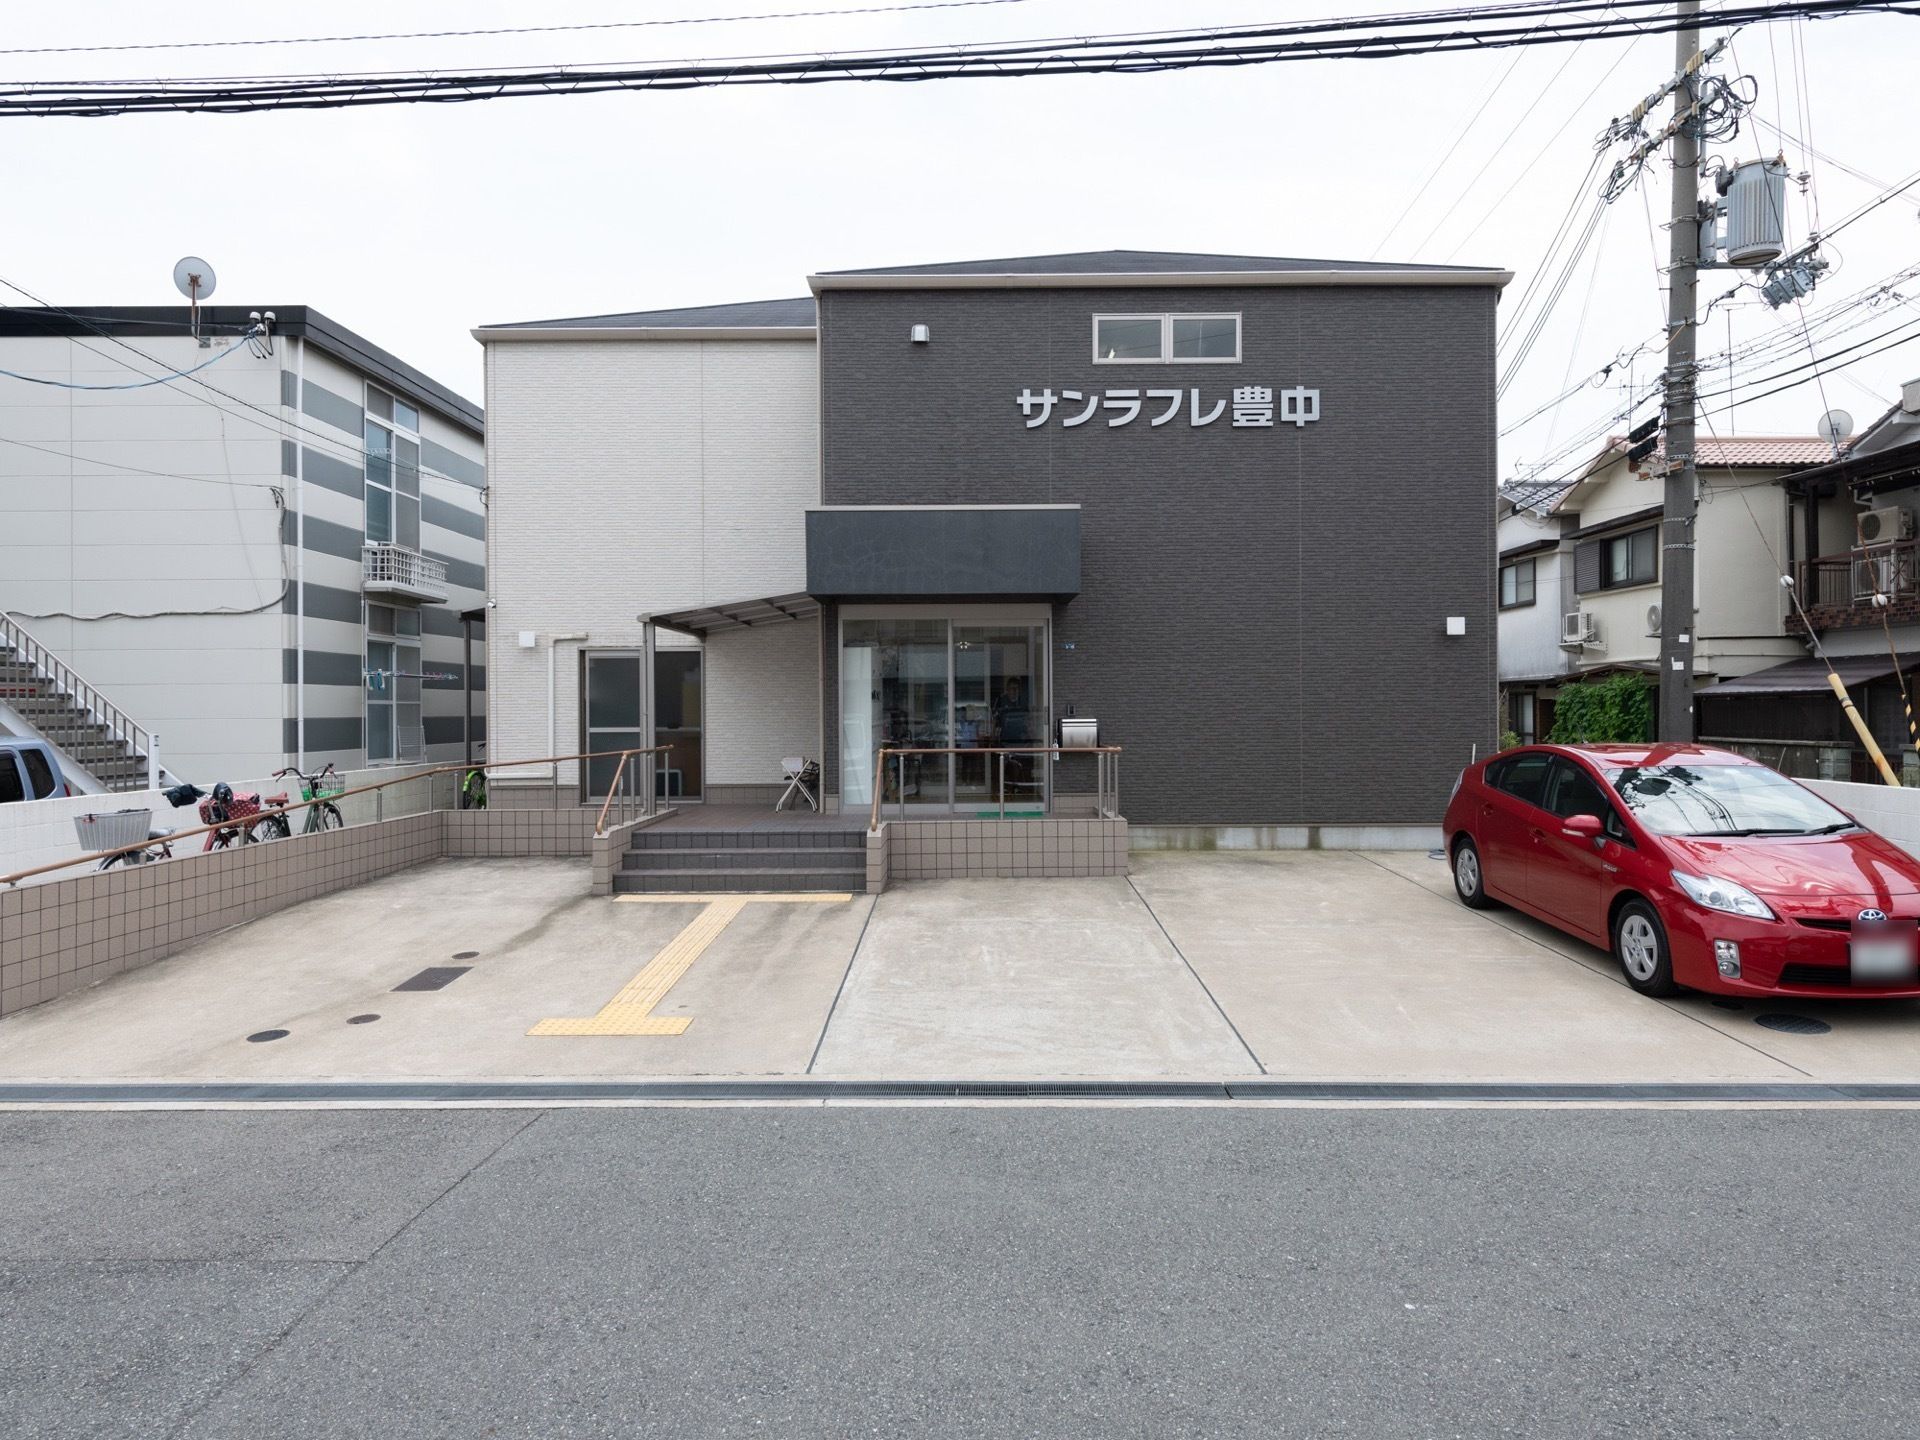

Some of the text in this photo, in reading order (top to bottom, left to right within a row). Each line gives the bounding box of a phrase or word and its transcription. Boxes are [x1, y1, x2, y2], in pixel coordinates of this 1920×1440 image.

[1016, 386, 1320, 428] サンラフレ豊中
